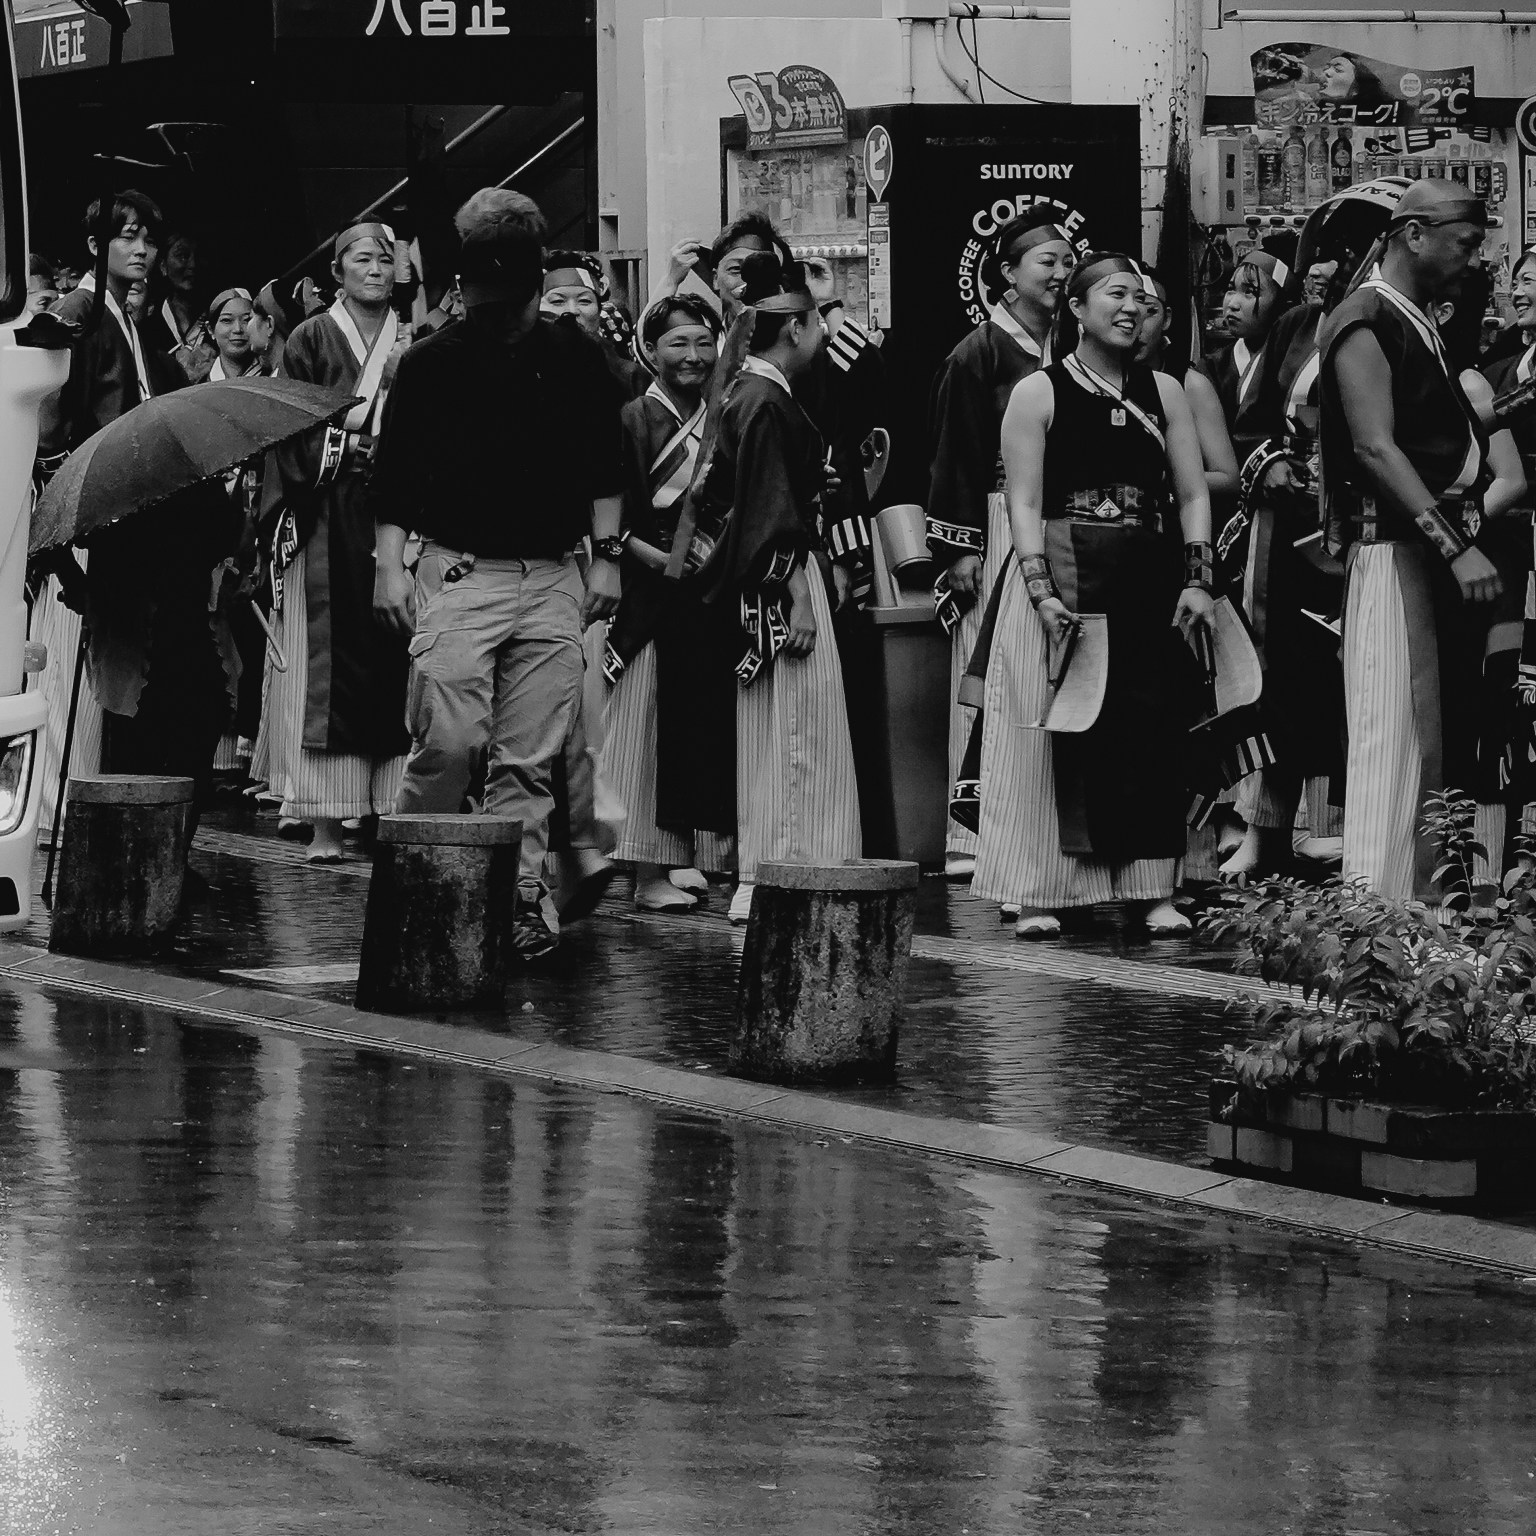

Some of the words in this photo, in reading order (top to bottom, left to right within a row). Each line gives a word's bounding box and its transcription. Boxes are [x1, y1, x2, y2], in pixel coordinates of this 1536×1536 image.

[40, 19, 86, 68] 八百正
[980, 164, 1074, 179] SUNTORY
